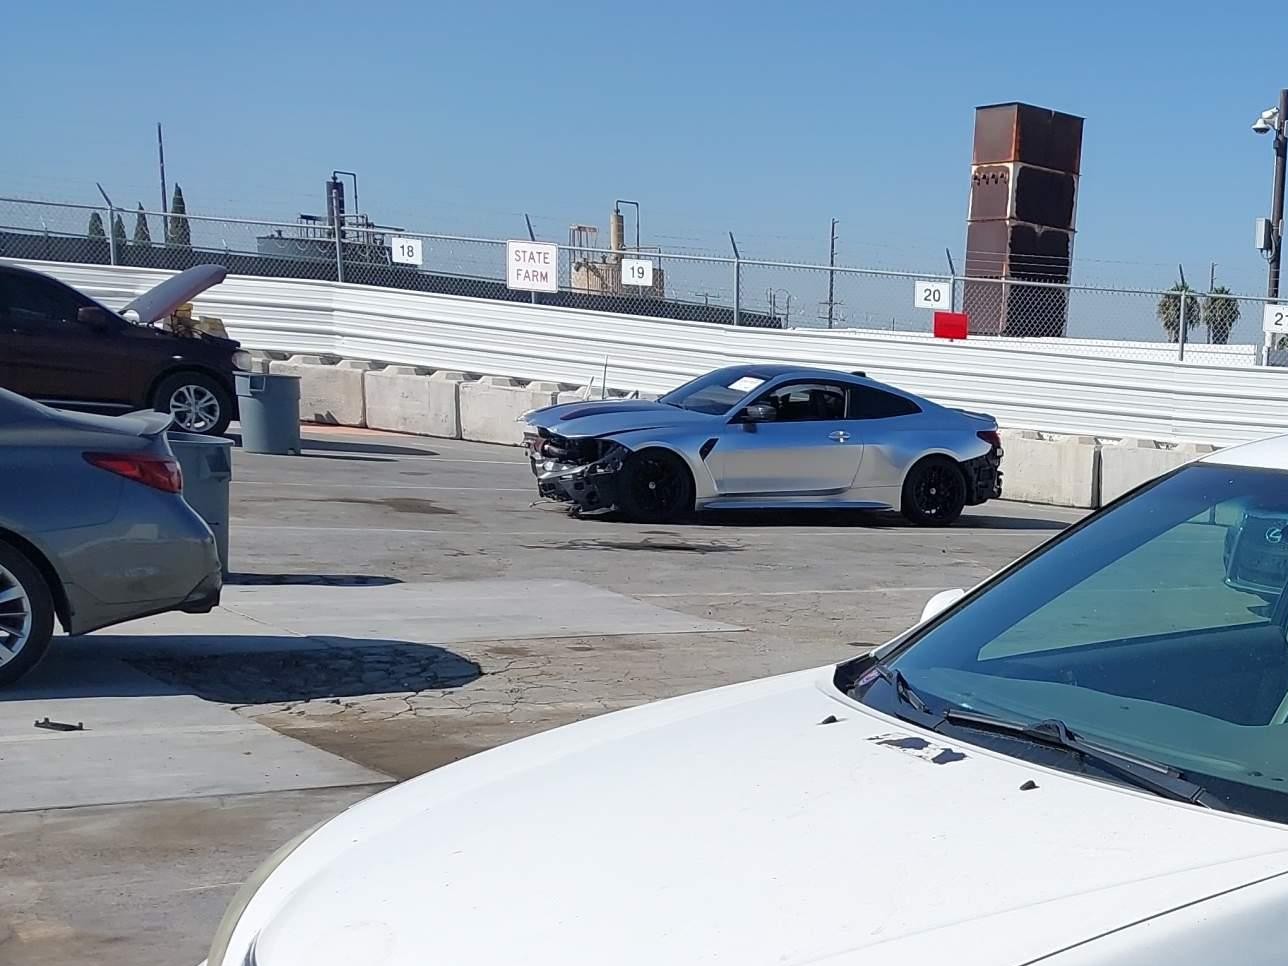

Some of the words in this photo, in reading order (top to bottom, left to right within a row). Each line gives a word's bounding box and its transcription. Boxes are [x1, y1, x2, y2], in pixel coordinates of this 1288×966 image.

[399, 244, 415, 258] 18
[514, 249, 551, 265] STATE
[516, 268, 549, 283] FARM
[629, 265, 646, 279] 19
[923, 288, 942, 303] 20
